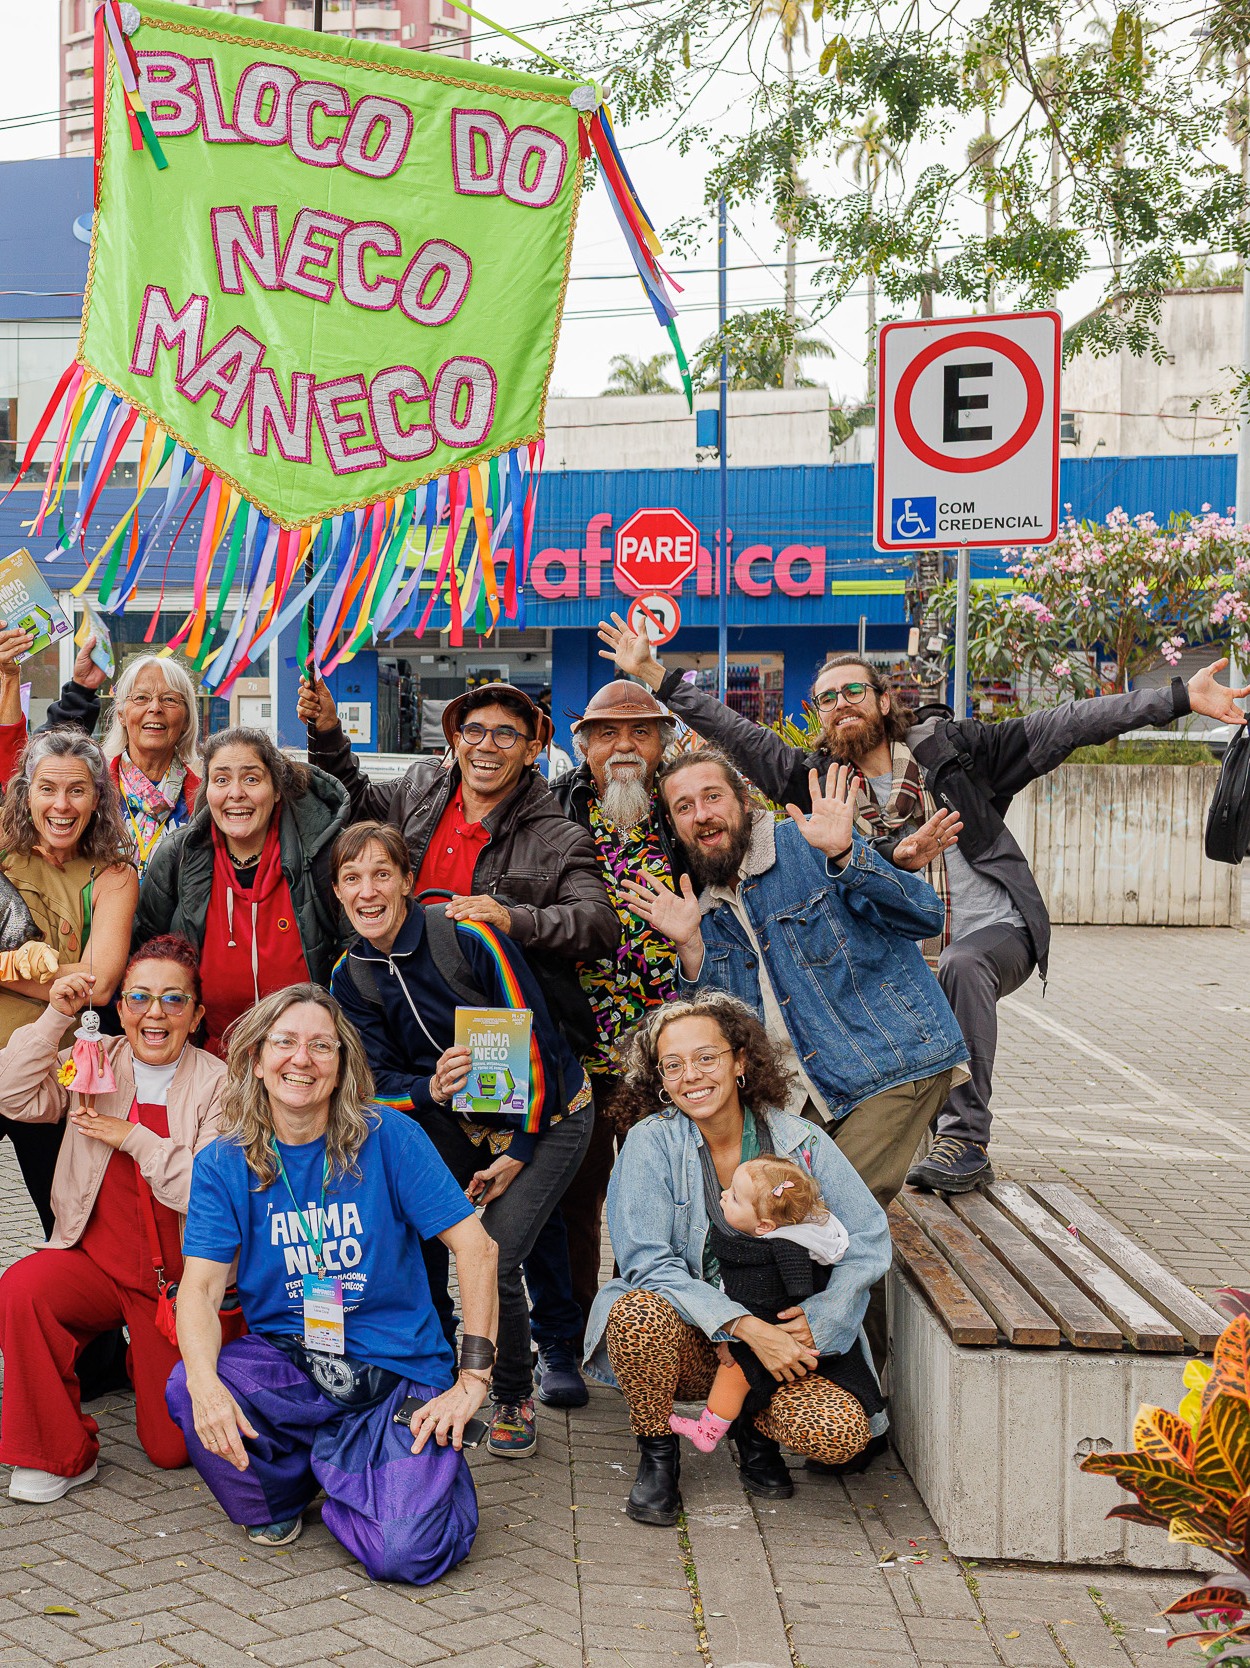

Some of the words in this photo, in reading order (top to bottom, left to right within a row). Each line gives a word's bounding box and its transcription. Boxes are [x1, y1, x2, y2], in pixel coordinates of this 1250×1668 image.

[136, 50, 413, 178] BLOCO
[451, 107, 567, 208] DO
[210, 205, 472, 327] NECO
[129, 285, 498, 475] MANECO
[943, 362, 993, 443] E
[938, 501, 975, 515] COM
[938, 515, 1043, 531] CREDENCIAL
[478, 508, 826, 598] afnica
[622, 536, 691, 563] PARE
[0, 590, 30, 615] NECO
[346, 685, 361, 694] 42
[474, 1047, 508, 1060] NECO
[285, 1279, 304, 1291] FESTI
[288, 1290, 298, 1299] DE
[341, 1281, 365, 1292] ONECOS
